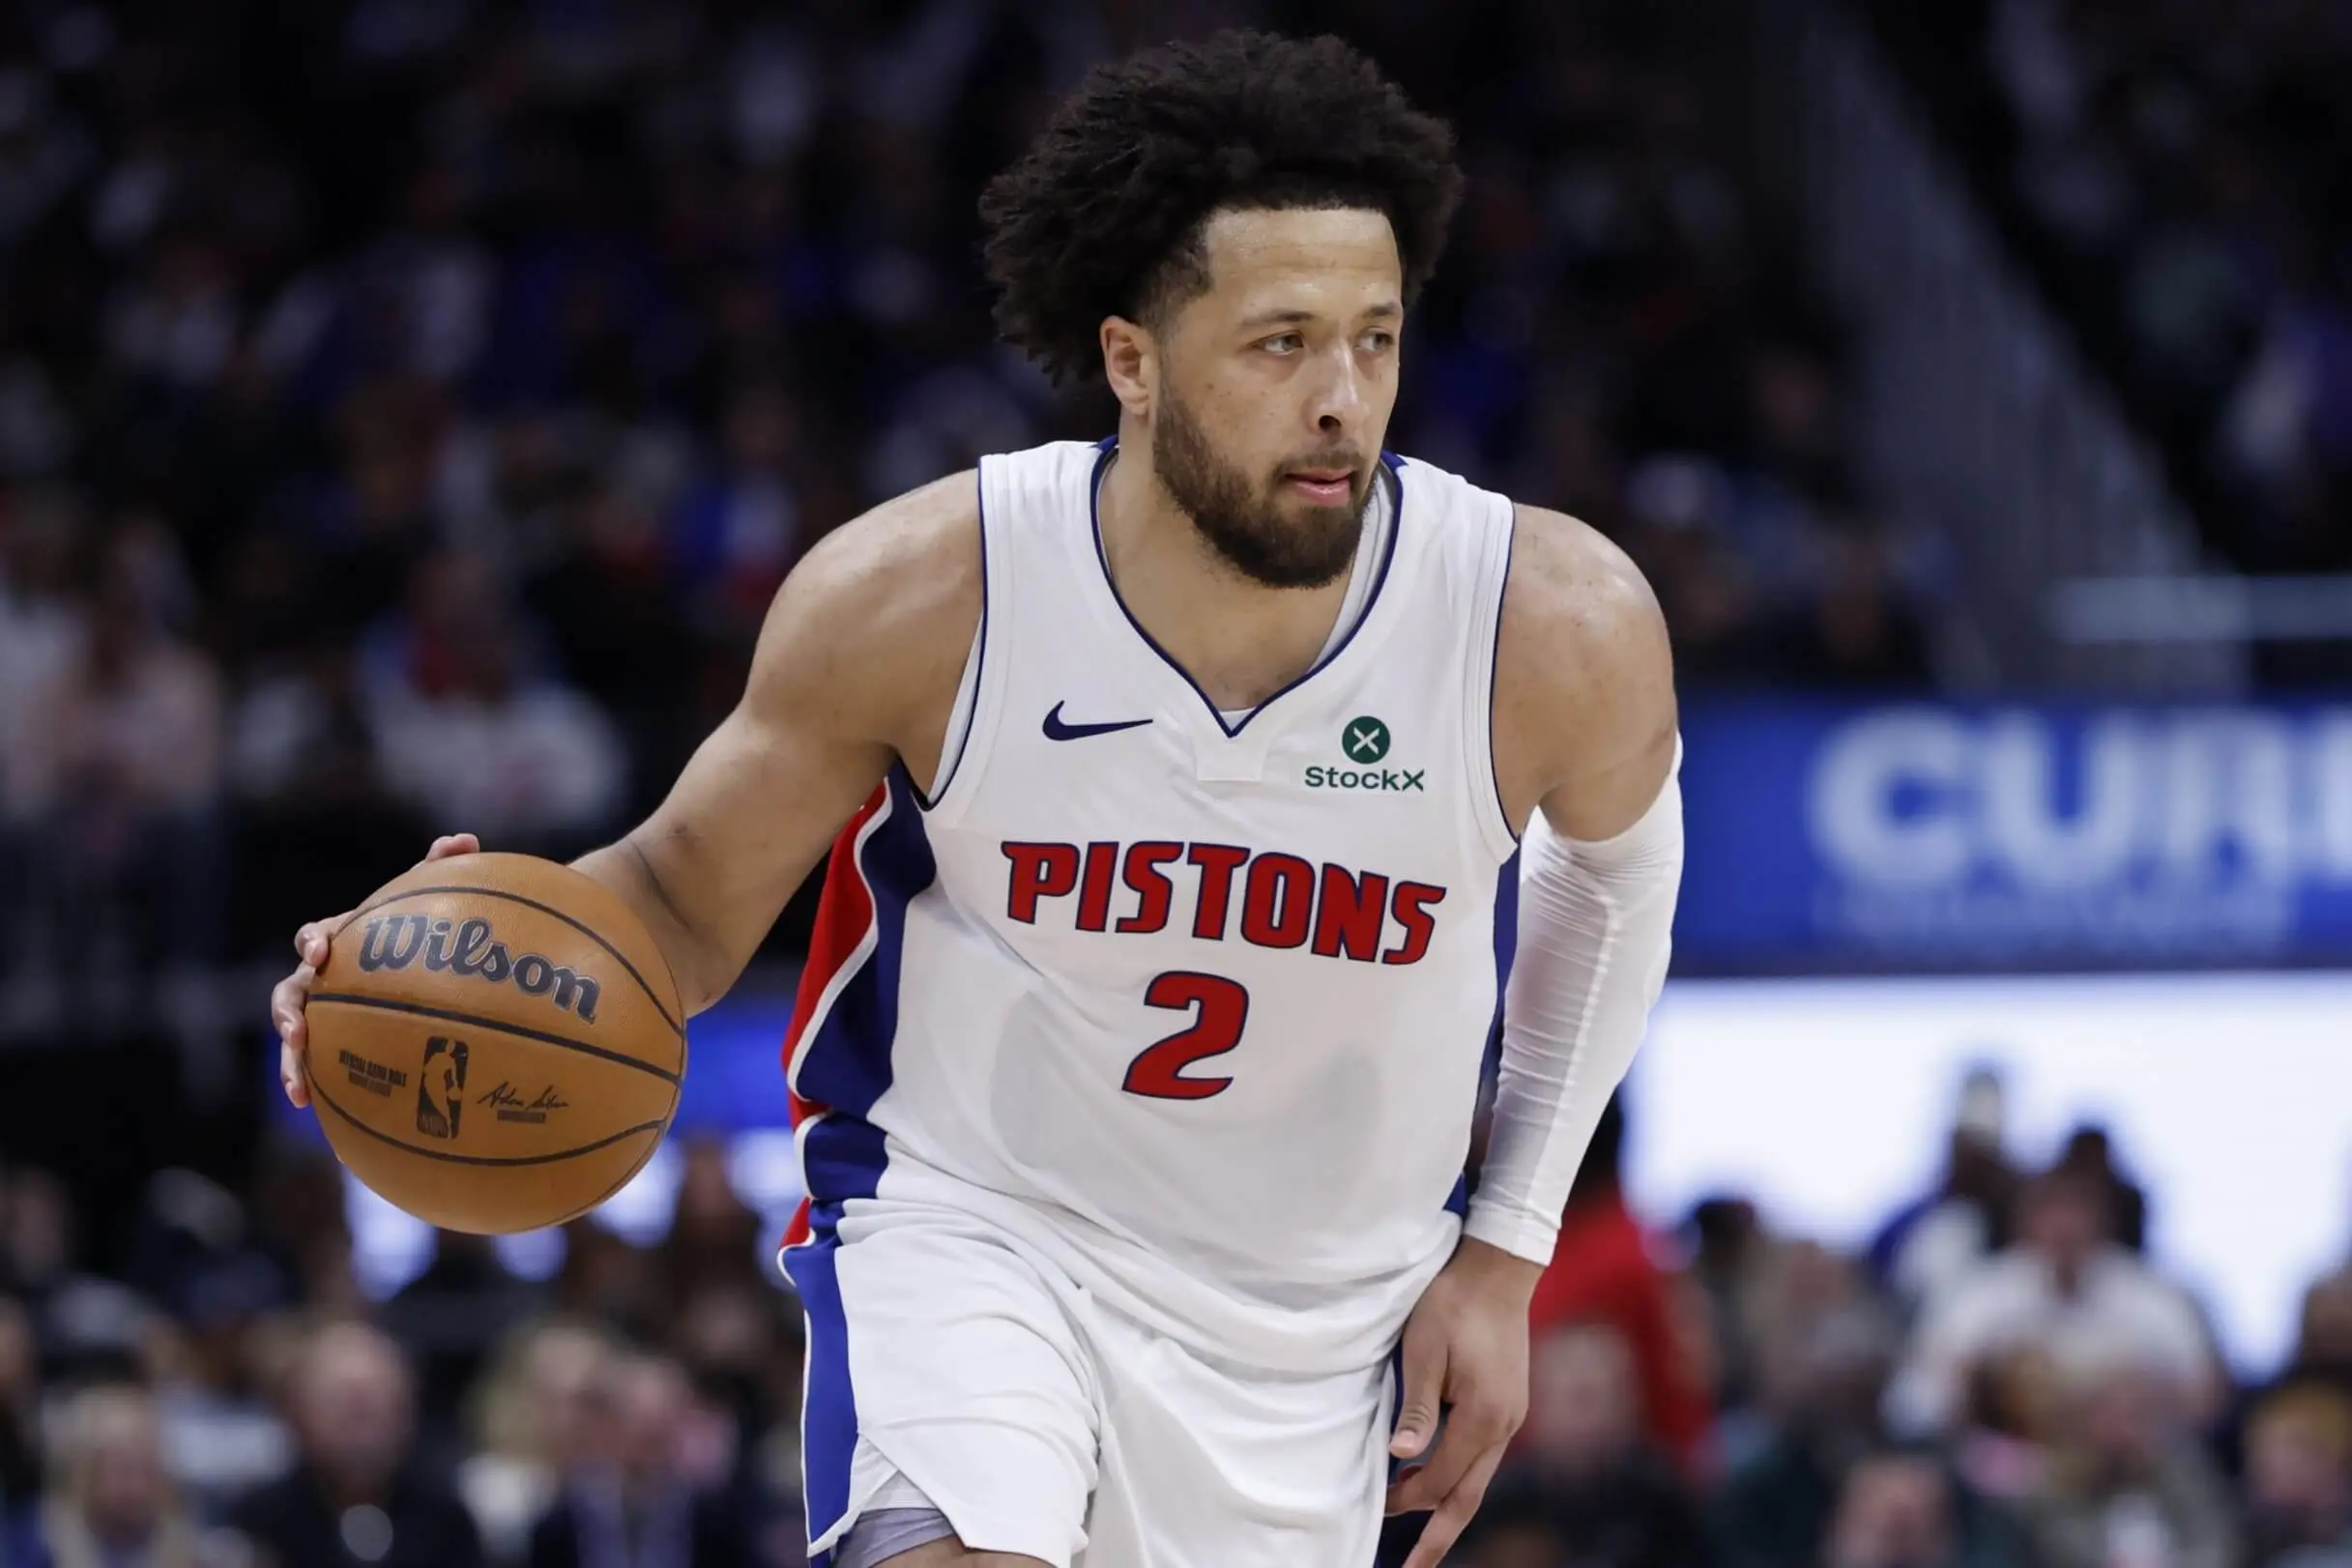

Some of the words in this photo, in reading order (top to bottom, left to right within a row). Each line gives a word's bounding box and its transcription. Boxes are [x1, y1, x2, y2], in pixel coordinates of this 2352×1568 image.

[1304, 766, 1425, 792] StockX
[1000, 840, 1447, 966] PISTONS
[358, 913, 600, 1025] Wilson
[1121, 970, 1250, 1100] 2
